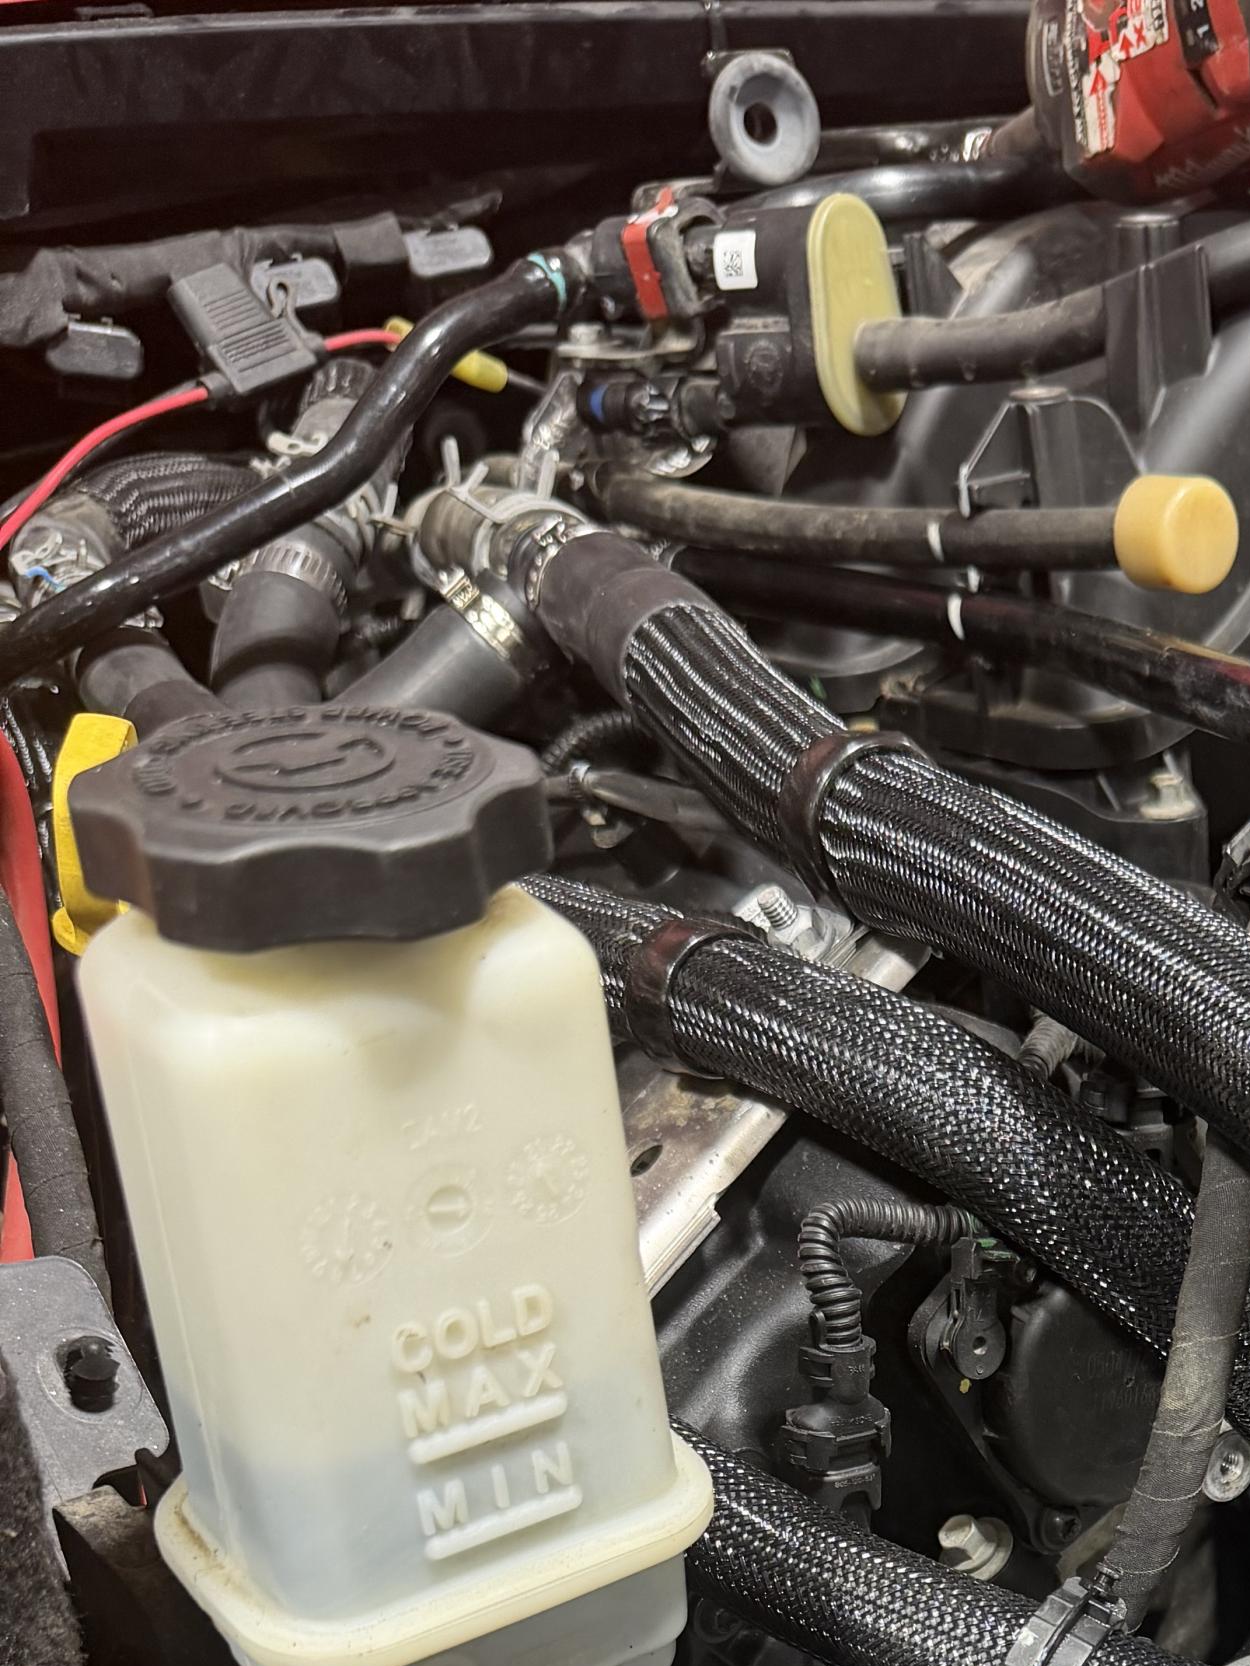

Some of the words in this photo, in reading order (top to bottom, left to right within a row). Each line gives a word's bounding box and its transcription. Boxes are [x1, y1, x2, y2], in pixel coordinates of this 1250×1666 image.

[392, 1281, 555, 1374] COLD
[399, 1340, 565, 1440] MAX
[416, 1440, 575, 1537] MIN
